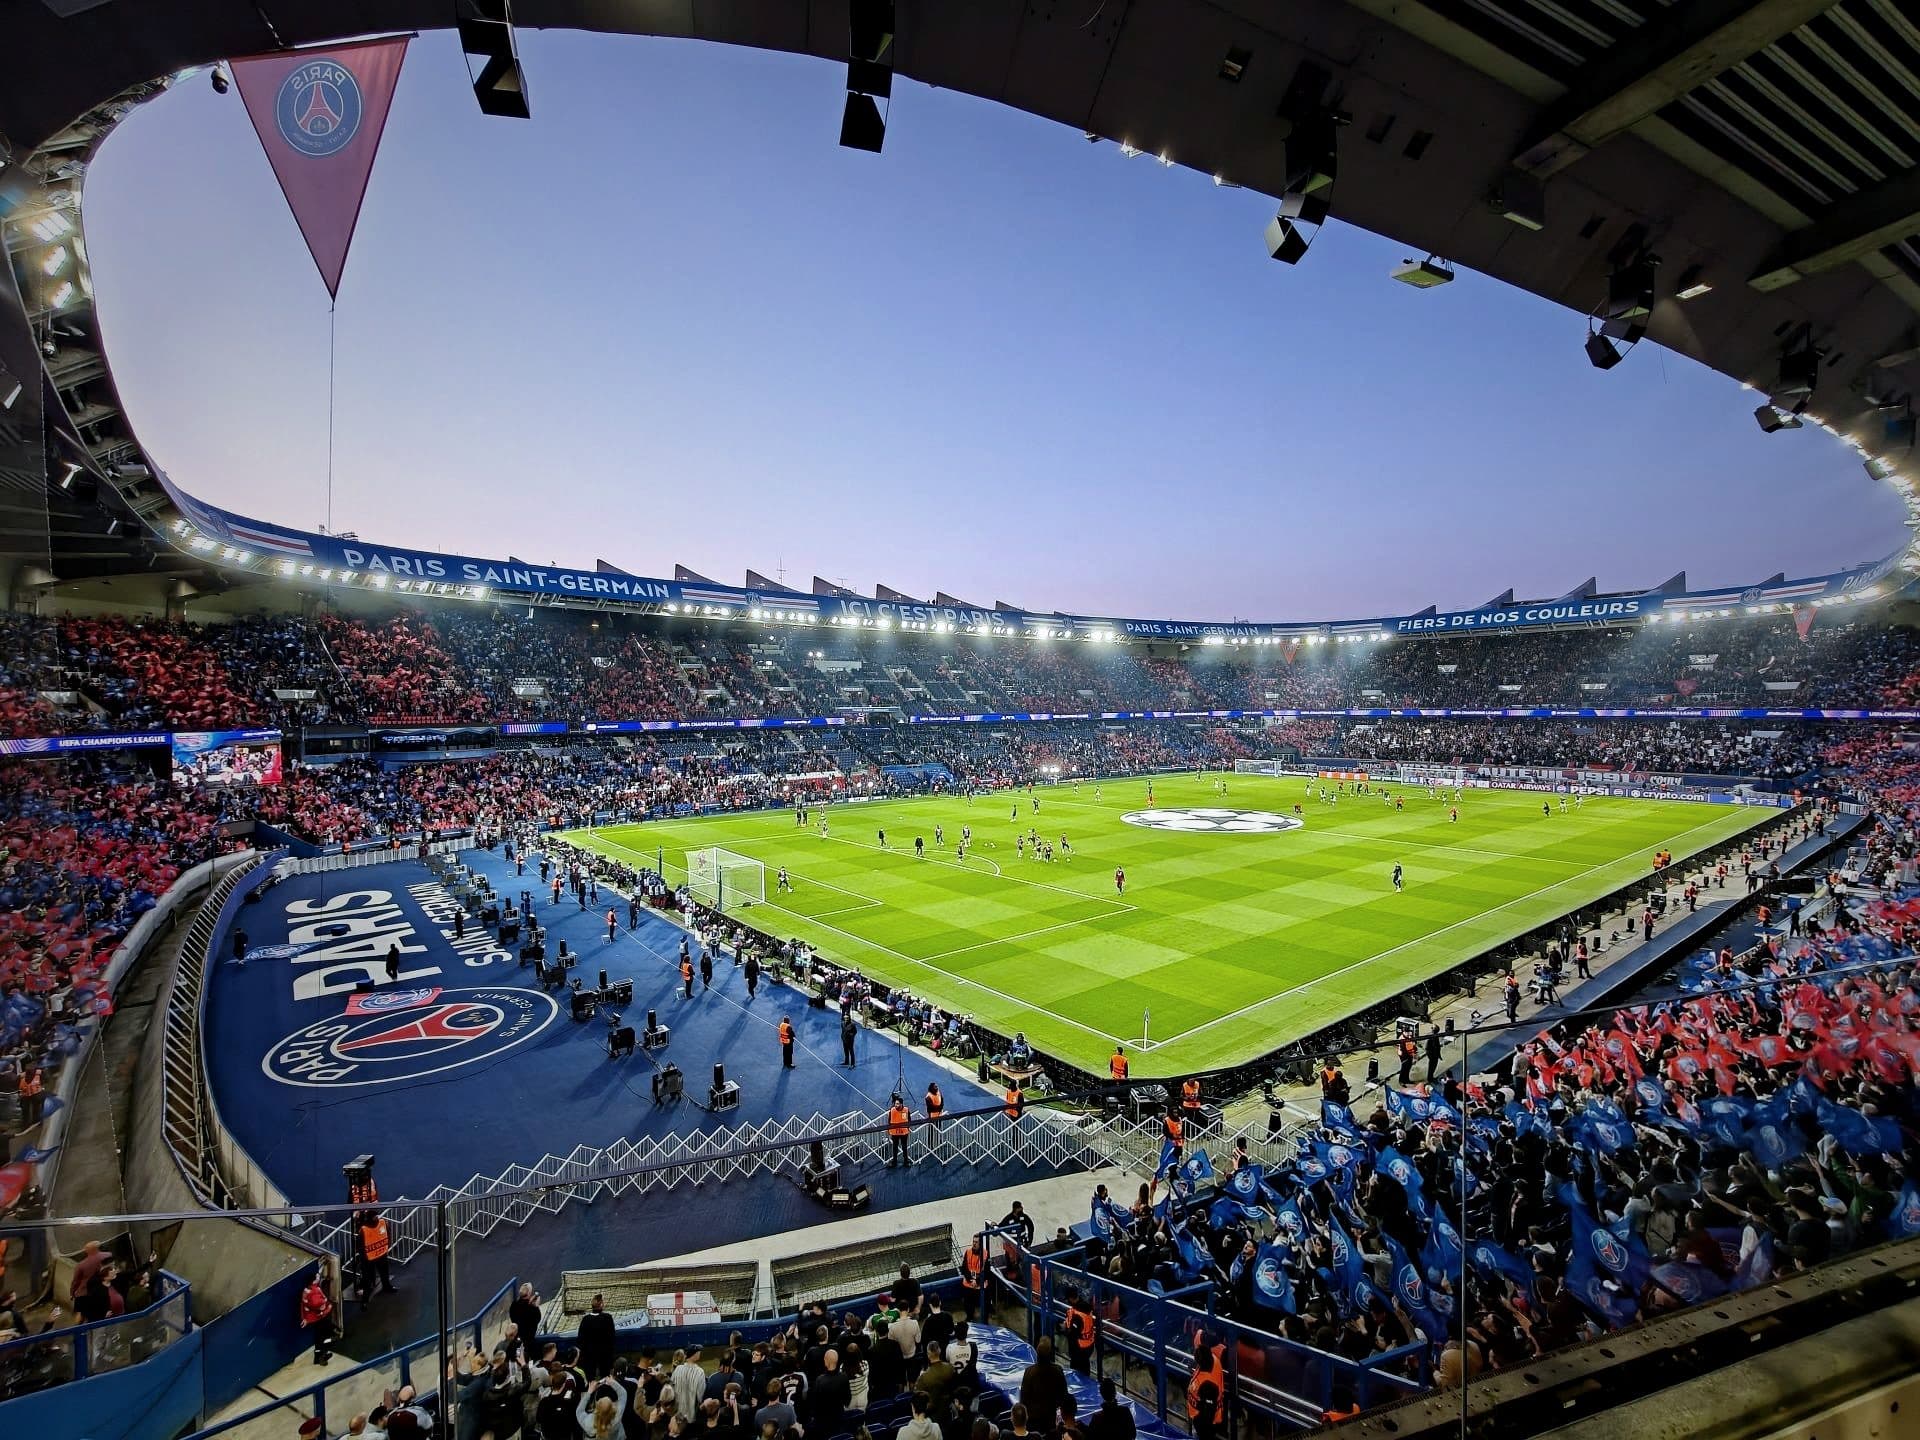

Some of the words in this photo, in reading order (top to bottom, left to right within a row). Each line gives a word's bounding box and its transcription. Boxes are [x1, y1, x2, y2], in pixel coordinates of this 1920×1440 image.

[343, 548, 446, 577] PARIS
[462, 563, 670, 598] SAINT-GERMAIN
[840, 600, 871, 618] ICI
[877, 603, 938, 622] C'EST
[943, 608, 1006, 627] PARIS
[1397, 616, 1447, 631] FIERS
[1451, 614, 1475, 626] DE
[1479, 610, 1520, 624] NOS
[1525, 601, 1641, 622] COULEURS
[1125, 622, 1162, 634] PARIS
[1166, 623, 1259, 637] SAINT-GERMAIN
[60, 739, 81, 747] UEFA
[82, 737, 133, 746] CHAMPIONS
[134, 735, 166, 744] LEAGUE
[1477, 767, 1568, 780] AUTEUIL
[1576, 771, 1630, 783] 1991
[1491, 781, 1517, 789] QATAR
[1518, 783, 1552, 792] AIRWAYS
[1570, 785, 1610, 796] PEPSI
[1642, 791, 1705, 801] crypto.com
[404, 881, 471, 923] GERMAIN
[285, 890, 443, 1001] PARIS
[439, 926, 513, 967] SAINT
[498, 1013, 536, 1037] SAINT
[279, 1024, 360, 1081] PARIS
